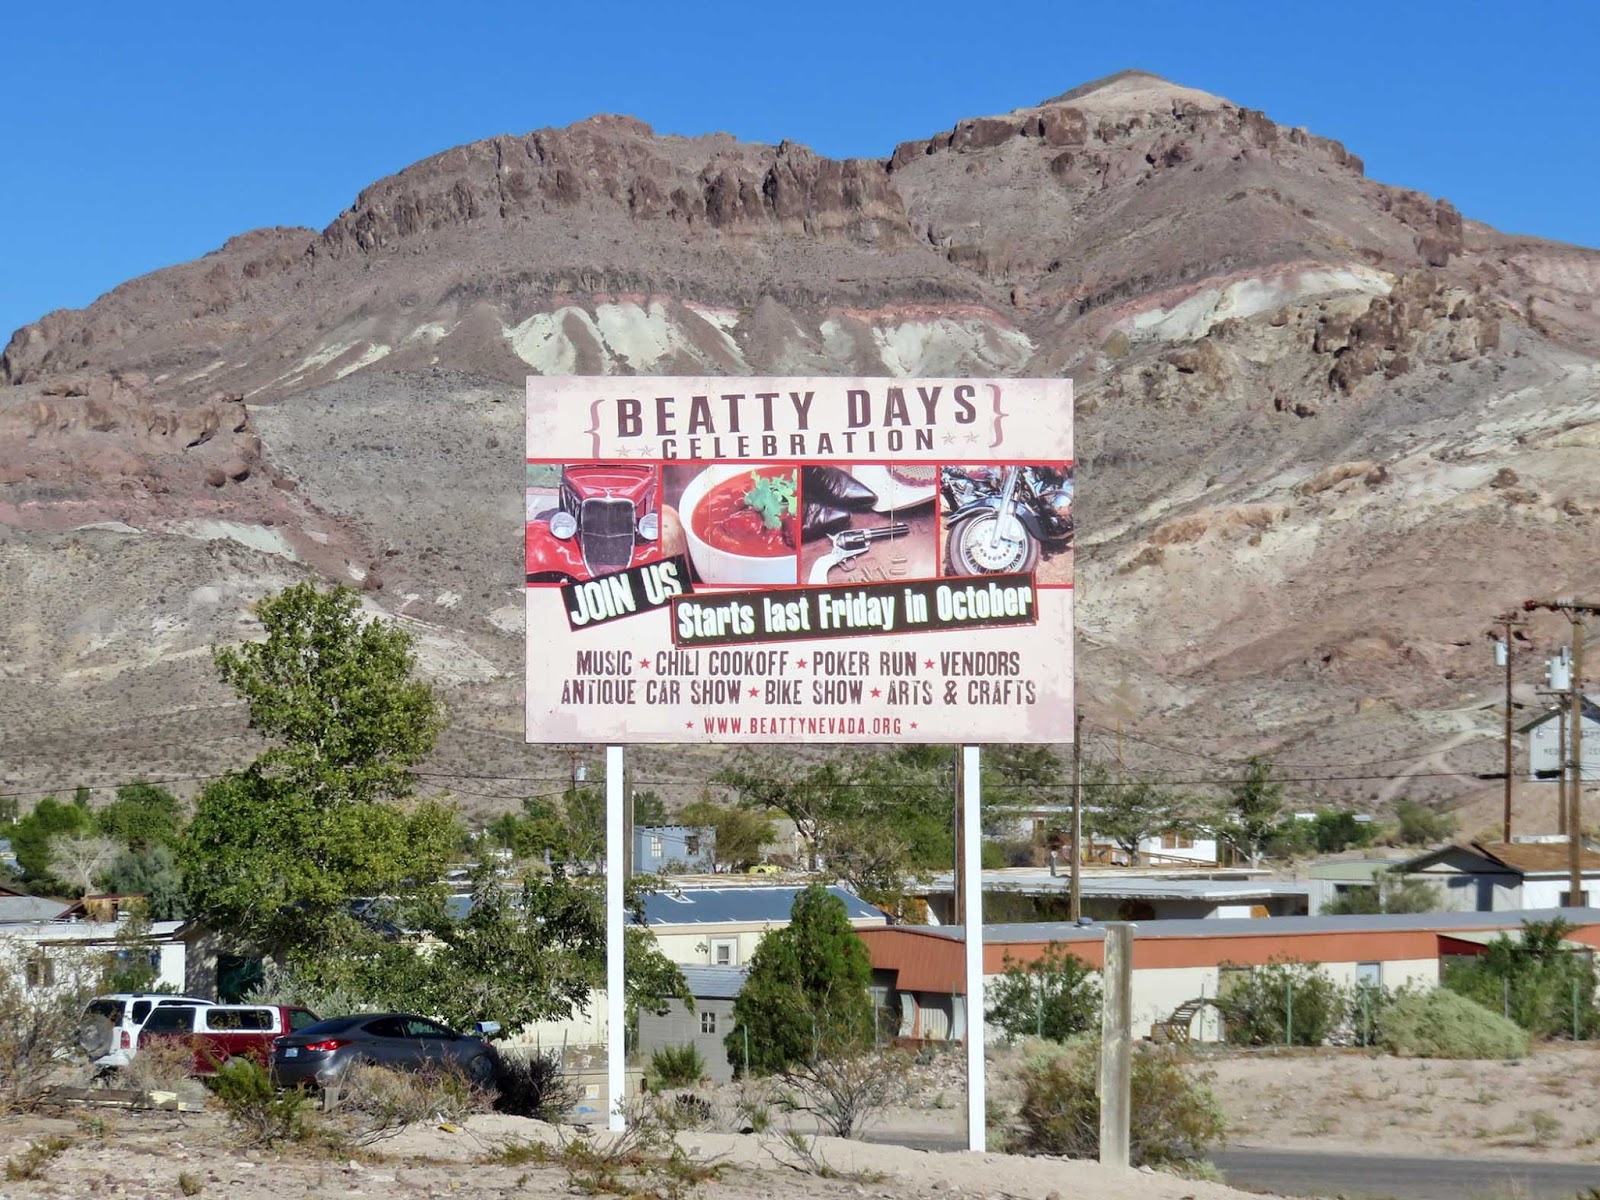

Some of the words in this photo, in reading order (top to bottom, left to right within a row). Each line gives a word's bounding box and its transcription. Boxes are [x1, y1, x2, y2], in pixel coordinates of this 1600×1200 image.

[616, 391, 815, 438] BEATTY
[846, 384, 977, 429] DAYS
[662, 428, 934, 460] CELEBRATION
[570, 573, 637, 626] JOIN
[641, 561, 683, 605] US
[678, 601, 754, 639] Starts
[763, 597, 811, 632] last
[818, 591, 895, 631] Friday
[904, 588, 928, 623] in
[936, 582, 1033, 622] October
[576, 650, 633, 676] MUSIC
[655, 650, 699, 676] CHILI
[708, 650, 790, 676] COOKOFF
[812, 651, 870, 676] POKER
[879, 651, 917, 676] RUN
[940, 651, 1020, 676] VENDORS
[560, 679, 637, 705] ANTIQUE
[646, 679, 681, 705] CAR
[690, 679, 742, 705] SHOW
[765, 679, 803, 705] BIKE
[812, 679, 863, 705] SHOW
[887, 680, 933, 705] ARTS
[943, 680, 958, 705] &
[967, 680, 1037, 705] CRAFTS
[704, 716, 902, 735] WWW.BEATTYNEVADA.ORG
